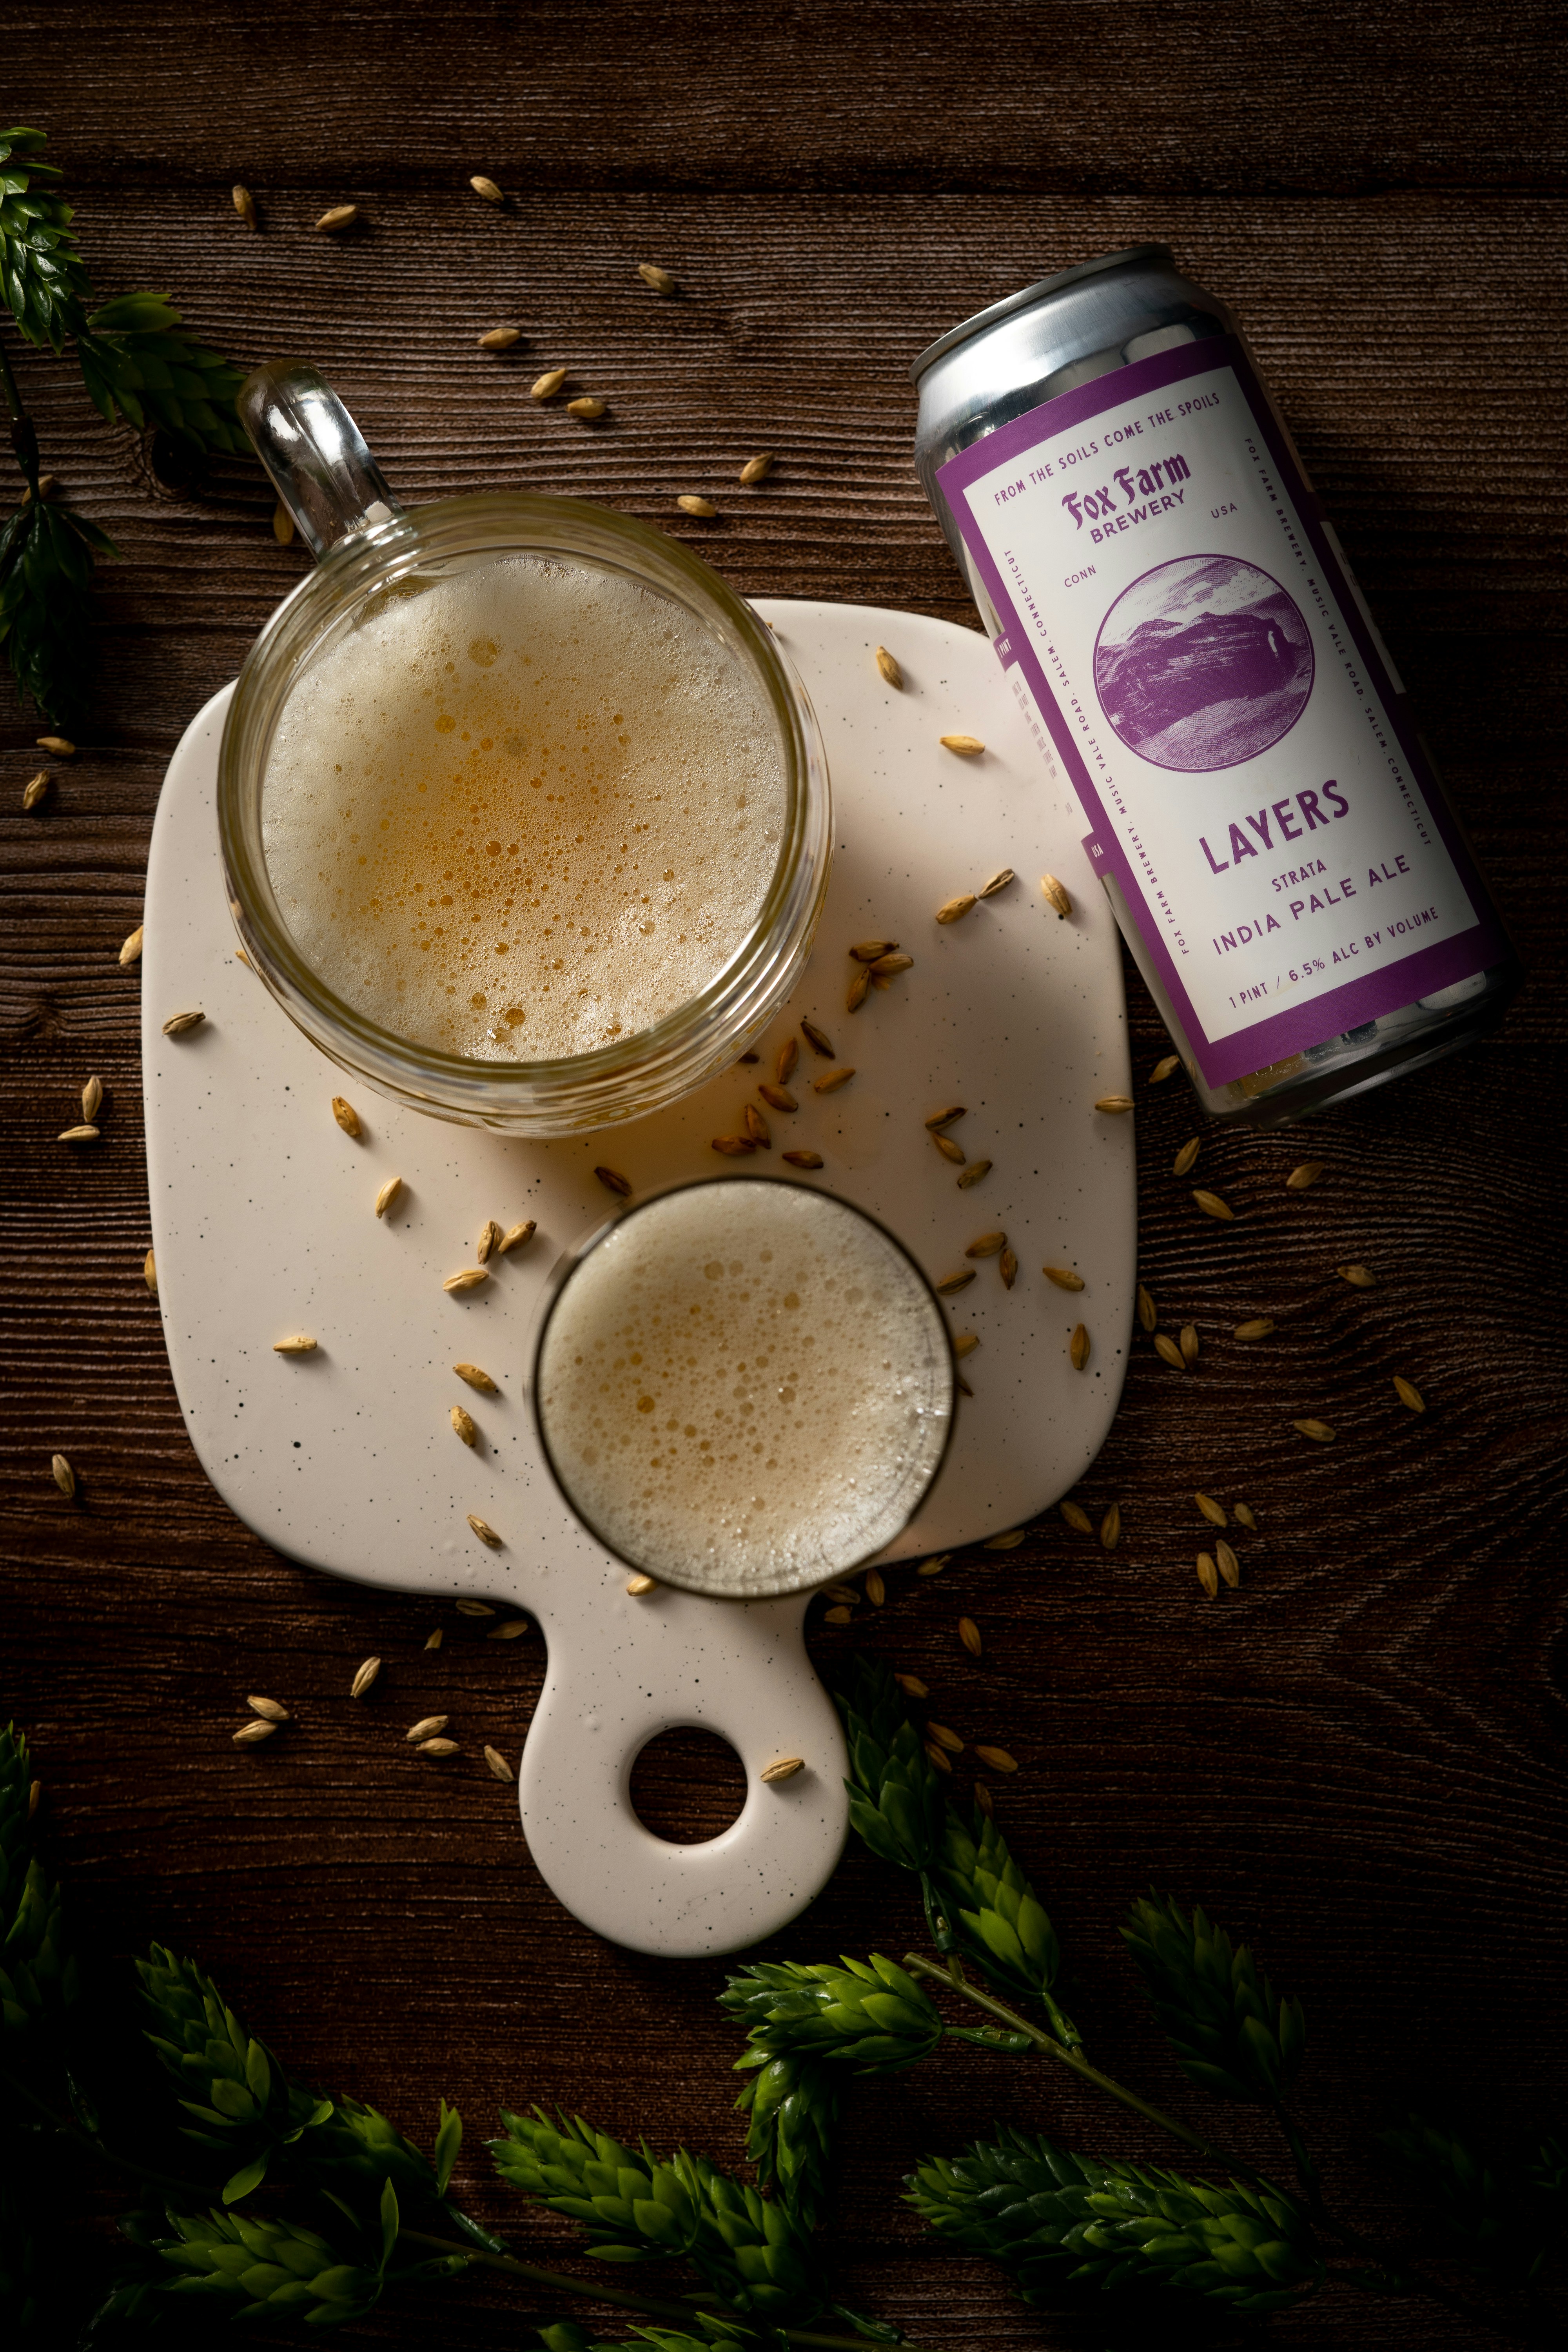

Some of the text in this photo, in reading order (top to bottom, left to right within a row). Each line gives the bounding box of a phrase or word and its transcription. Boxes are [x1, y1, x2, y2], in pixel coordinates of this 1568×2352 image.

[994, 392, 1220, 506] FROM THE SOILS COME THE SPOILS
[1062, 453, 1191, 530] Fox Farm
[1210, 503, 1238, 519] USA
[1090, 488, 1184, 544] BREWERY
[1004, 550, 1047, 636] CONNECTICUT
[1064, 565, 1096, 587] CONN
[1244, 438, 1260, 462] FOX
[1258, 469, 1278, 502] FARM
[1307, 579, 1329, 617] MUSIC
[1328, 624, 1346, 655] VALE
[1388, 758, 1432, 845] CONNECTICUT
[1088, 738, 1106, 770] VALE
[1105, 776, 1127, 815] MUSIC
[1091, 843, 1104, 858] USA
[1199, 779, 1349, 875] LAYERS
[1272, 859, 1327, 892] STRATA
[1156, 891, 1175, 924] FARM
[1212, 854, 1410, 955] INDIA PALE ALE
[1174, 930, 1189, 955] FOX
[1229, 996, 1236, 1008] 1
[1239, 982, 1268, 1004] PINT
[1289, 957, 1325, 982] 6.5%
[1332, 942, 1359, 964] ALC
[1364, 931, 1381, 949] BY
[1387, 906, 1439, 938] VOLUME
